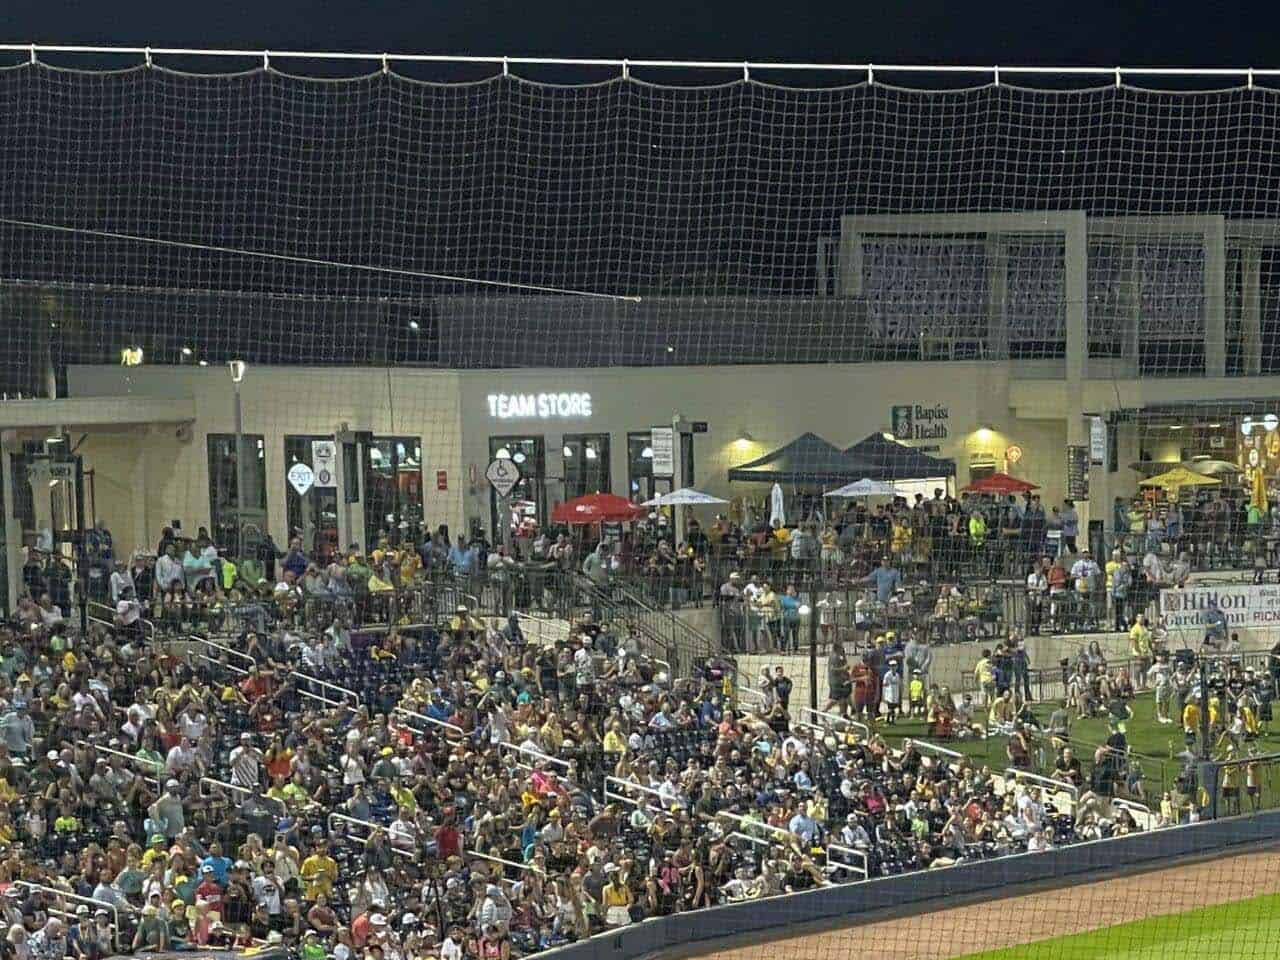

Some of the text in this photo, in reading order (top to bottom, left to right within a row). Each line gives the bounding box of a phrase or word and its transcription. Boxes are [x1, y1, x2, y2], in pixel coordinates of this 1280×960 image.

[487, 393, 592, 417] TEAM STORE
[915, 424, 947, 439] Health
[290, 471, 311, 481] EXIT
